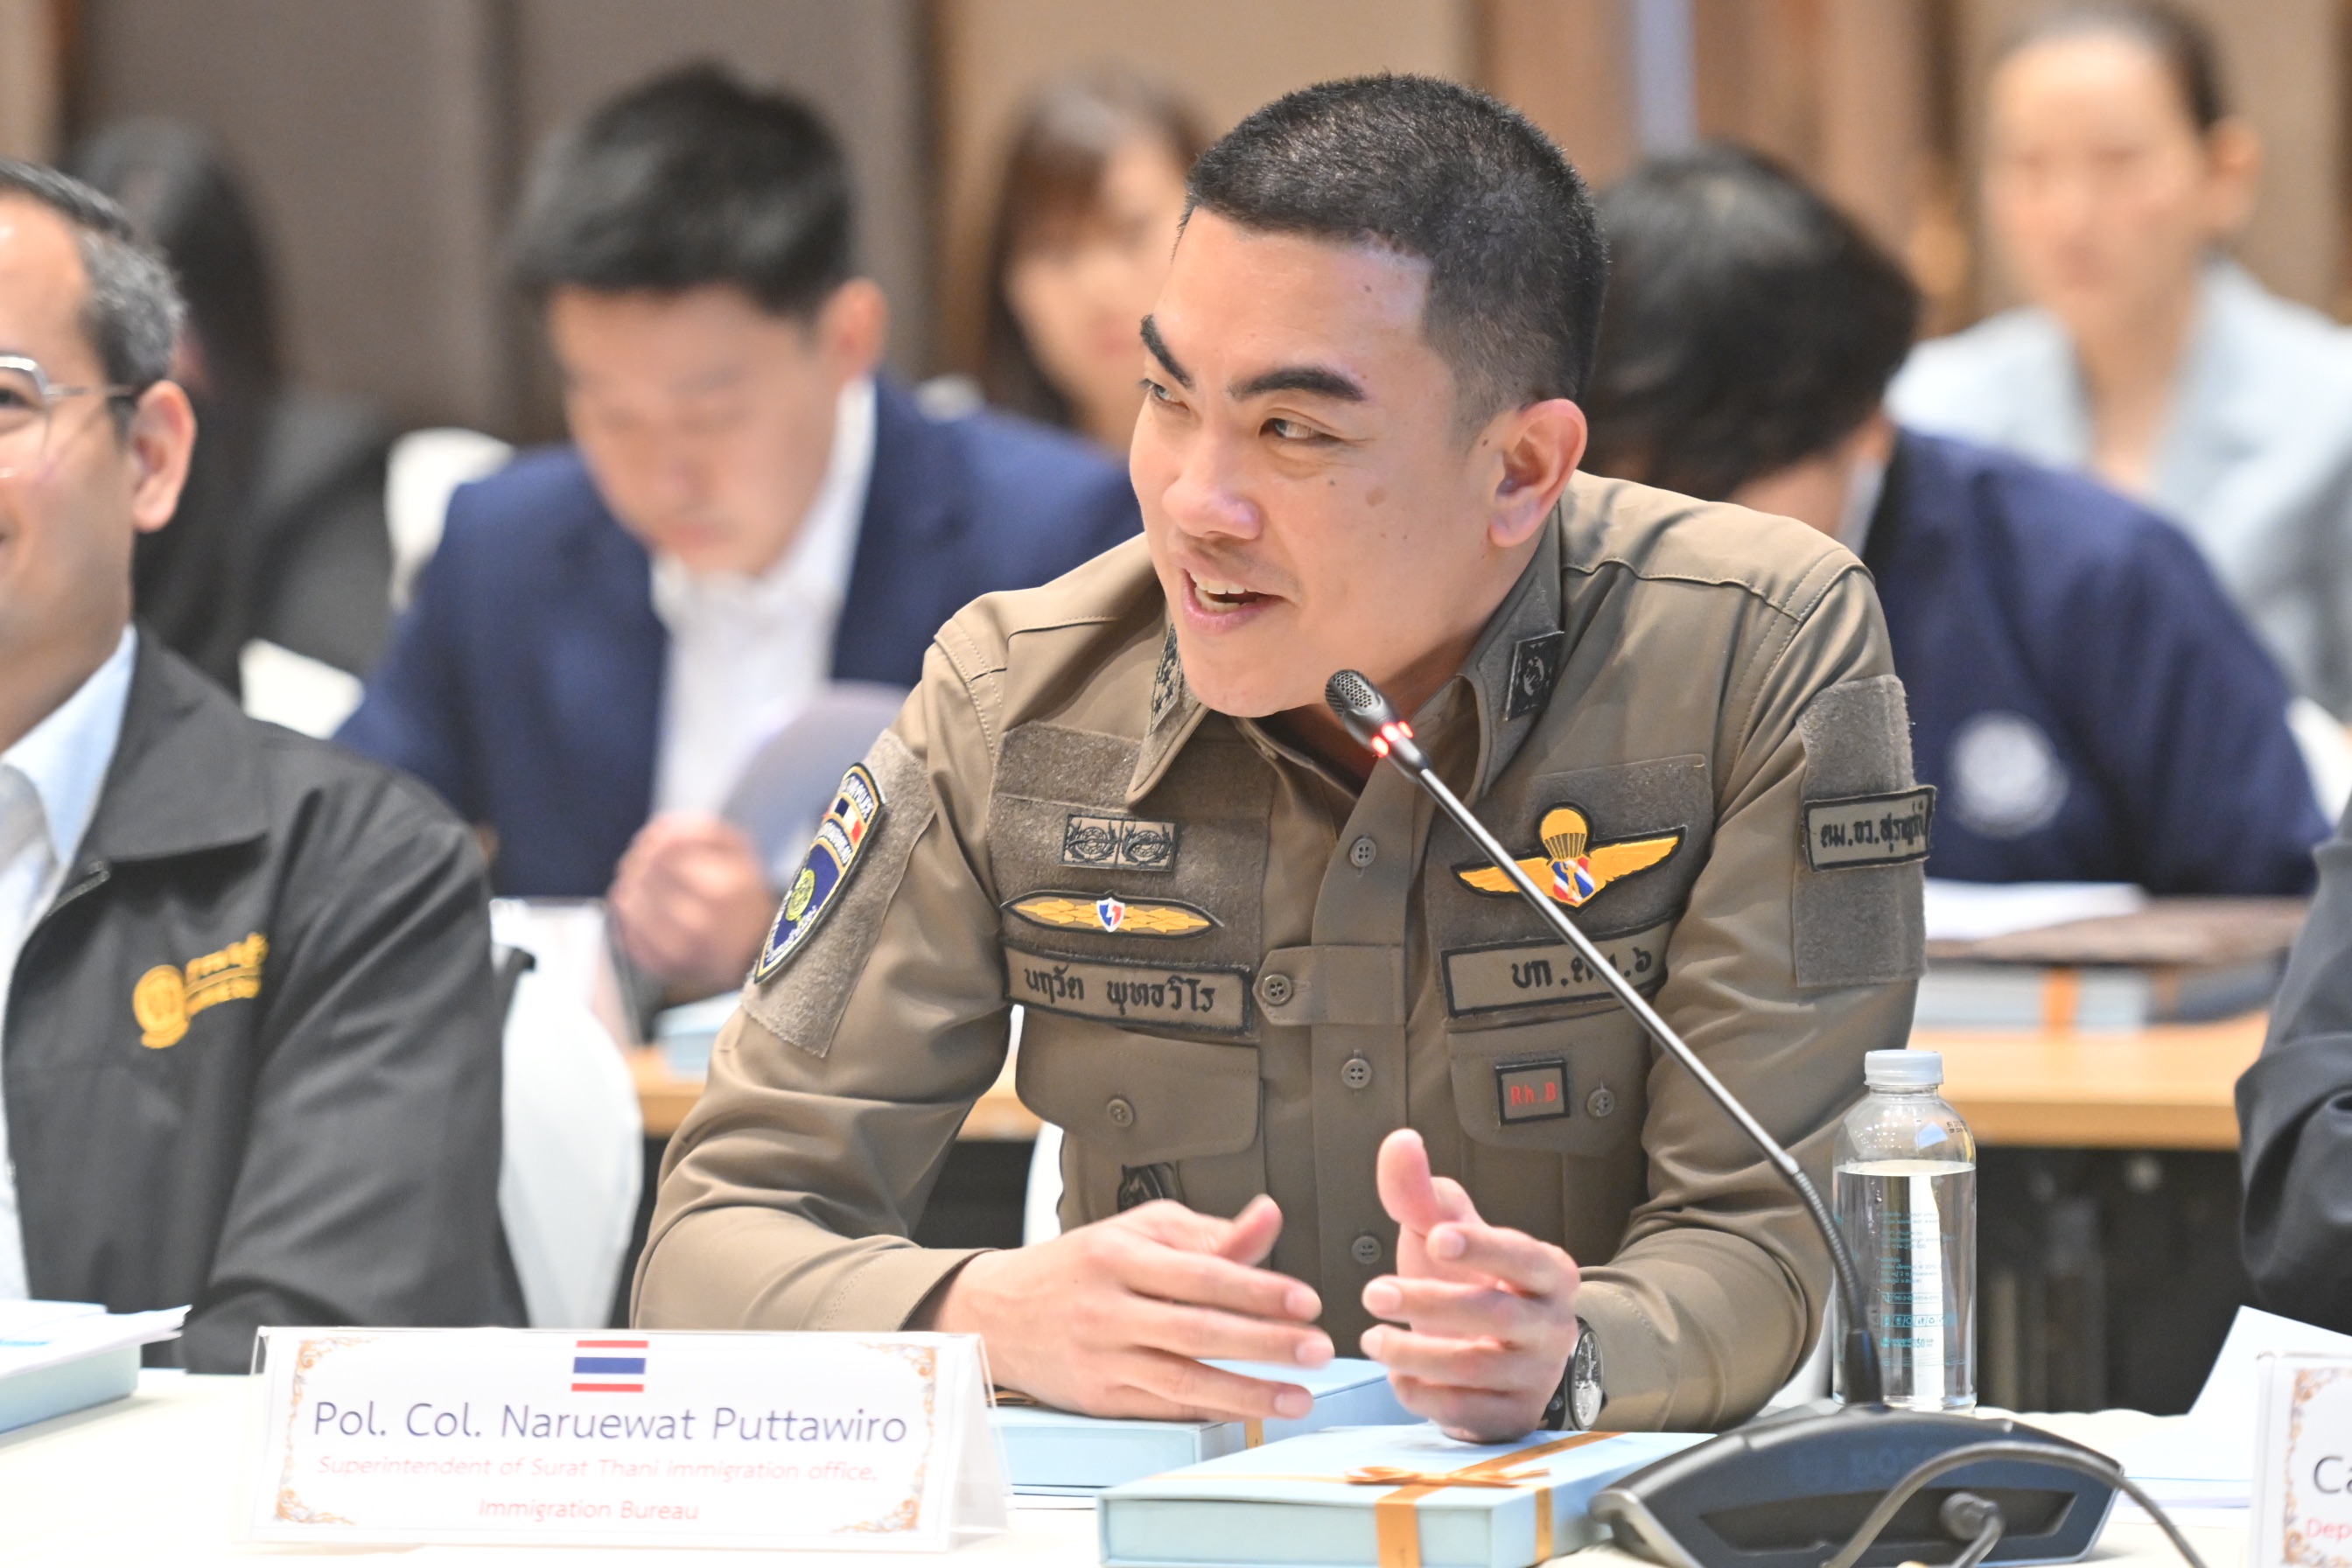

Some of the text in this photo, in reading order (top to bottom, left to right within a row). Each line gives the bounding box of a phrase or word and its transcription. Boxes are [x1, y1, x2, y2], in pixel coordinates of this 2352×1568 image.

[1511, 947, 1652, 989] บก.ต.๖
[315, 1401, 908, 1445] Pol. Col. Naruewat Puttawiro
[318, 1456, 493, 1477] Superintendent
[500, 1457, 527, 1477] of
[531, 1458, 590, 1477] Surat
[598, 1460, 661, 1478] Thani
[667, 1460, 800, 1483] immigration
[2313, 1455, 2352, 1496] C
[480, 1499, 699, 1523] Immigration Bureau
